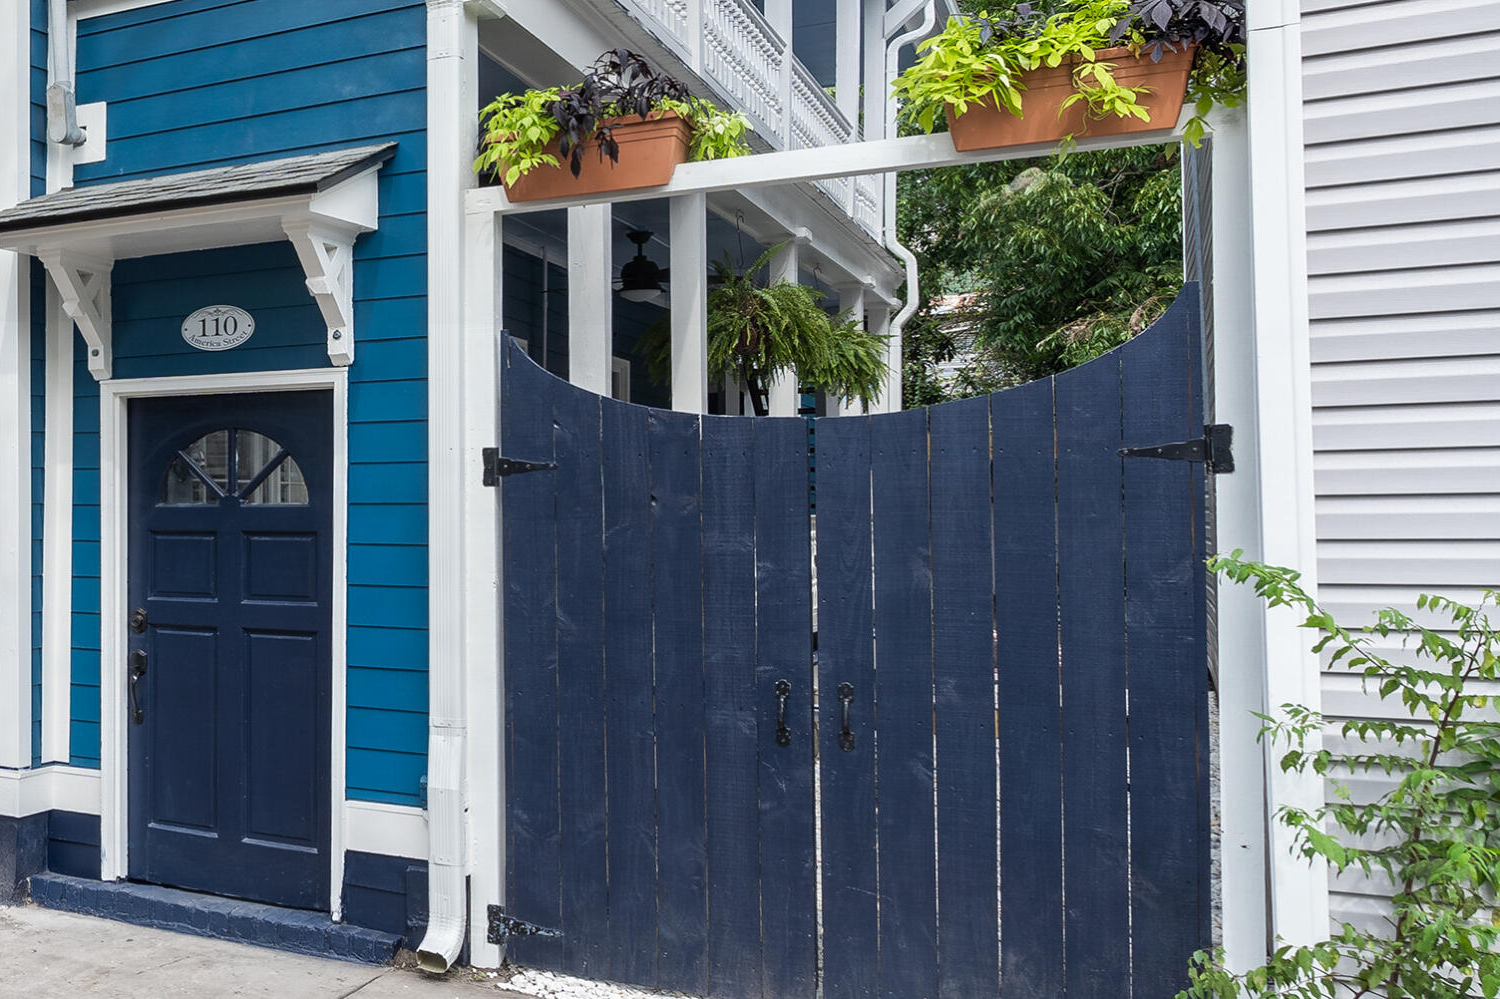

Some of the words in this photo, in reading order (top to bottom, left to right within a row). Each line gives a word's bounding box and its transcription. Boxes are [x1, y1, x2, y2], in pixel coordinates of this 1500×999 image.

[198, 315, 238, 338] 110
[188, 334, 221, 347] America
[223, 330, 248, 346] Street
